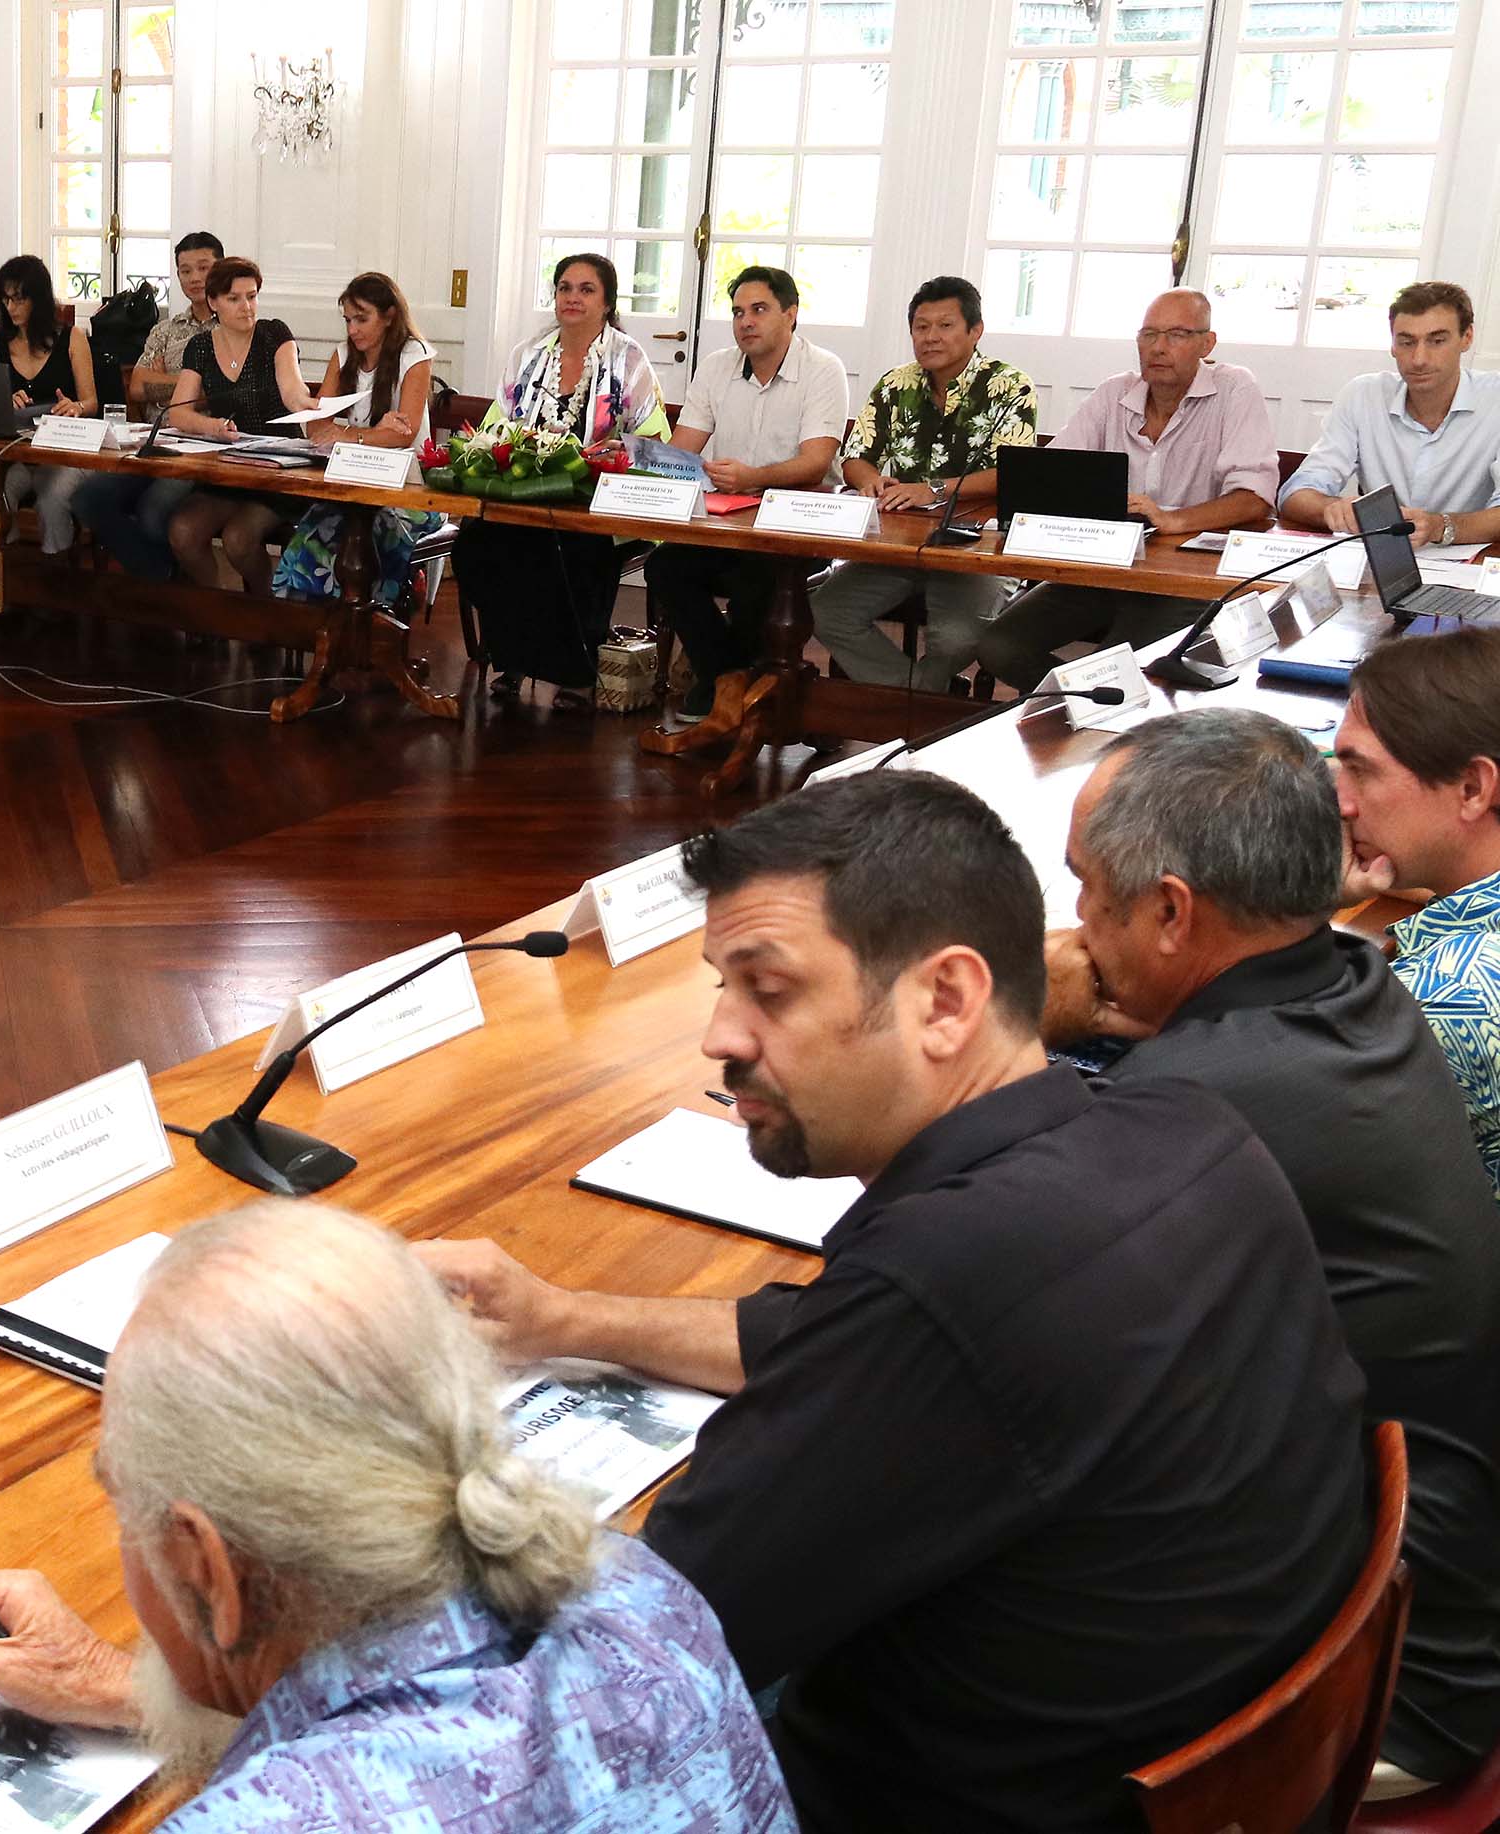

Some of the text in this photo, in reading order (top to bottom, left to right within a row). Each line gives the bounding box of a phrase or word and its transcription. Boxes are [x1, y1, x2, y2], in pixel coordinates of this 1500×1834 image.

[1039, 523, 1078, 533] Christopher
[52, 1103, 115, 1140] GUILLOUX
[55, 1132, 111, 1163] subaquatiques
[513, 1394, 585, 1444] OURISME
